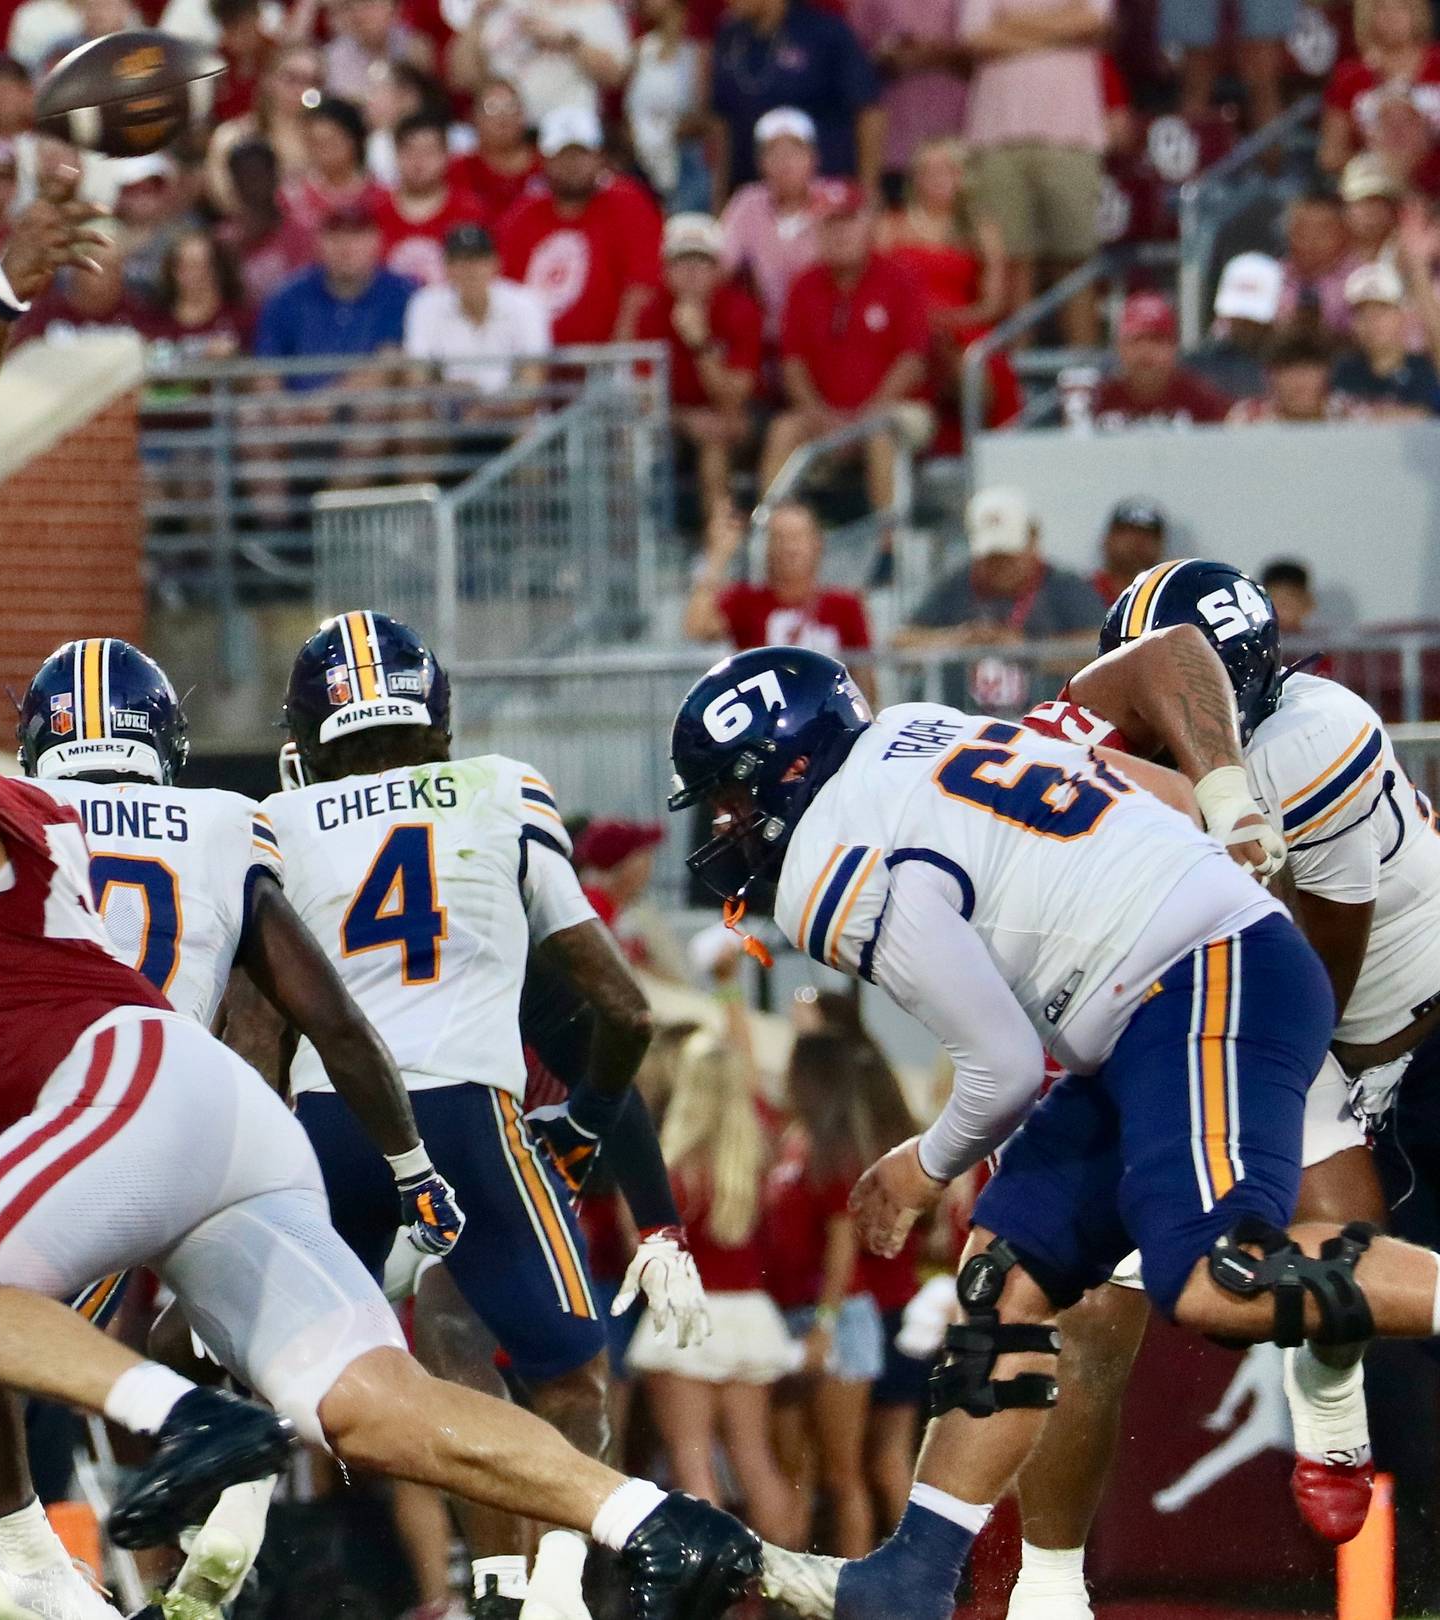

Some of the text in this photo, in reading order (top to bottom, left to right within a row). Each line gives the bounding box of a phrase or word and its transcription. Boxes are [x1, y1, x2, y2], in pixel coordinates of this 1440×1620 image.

[1196, 580, 1272, 642] 54
[116, 712, 147, 730] LUKE
[337, 705, 414, 728] MINERS
[702, 669, 788, 743] 67
[68, 743, 125, 757] MINERS
[881, 719, 964, 761] TRAPP
[316, 775, 457, 832] CHEEKS
[338, 822, 448, 987] 4
